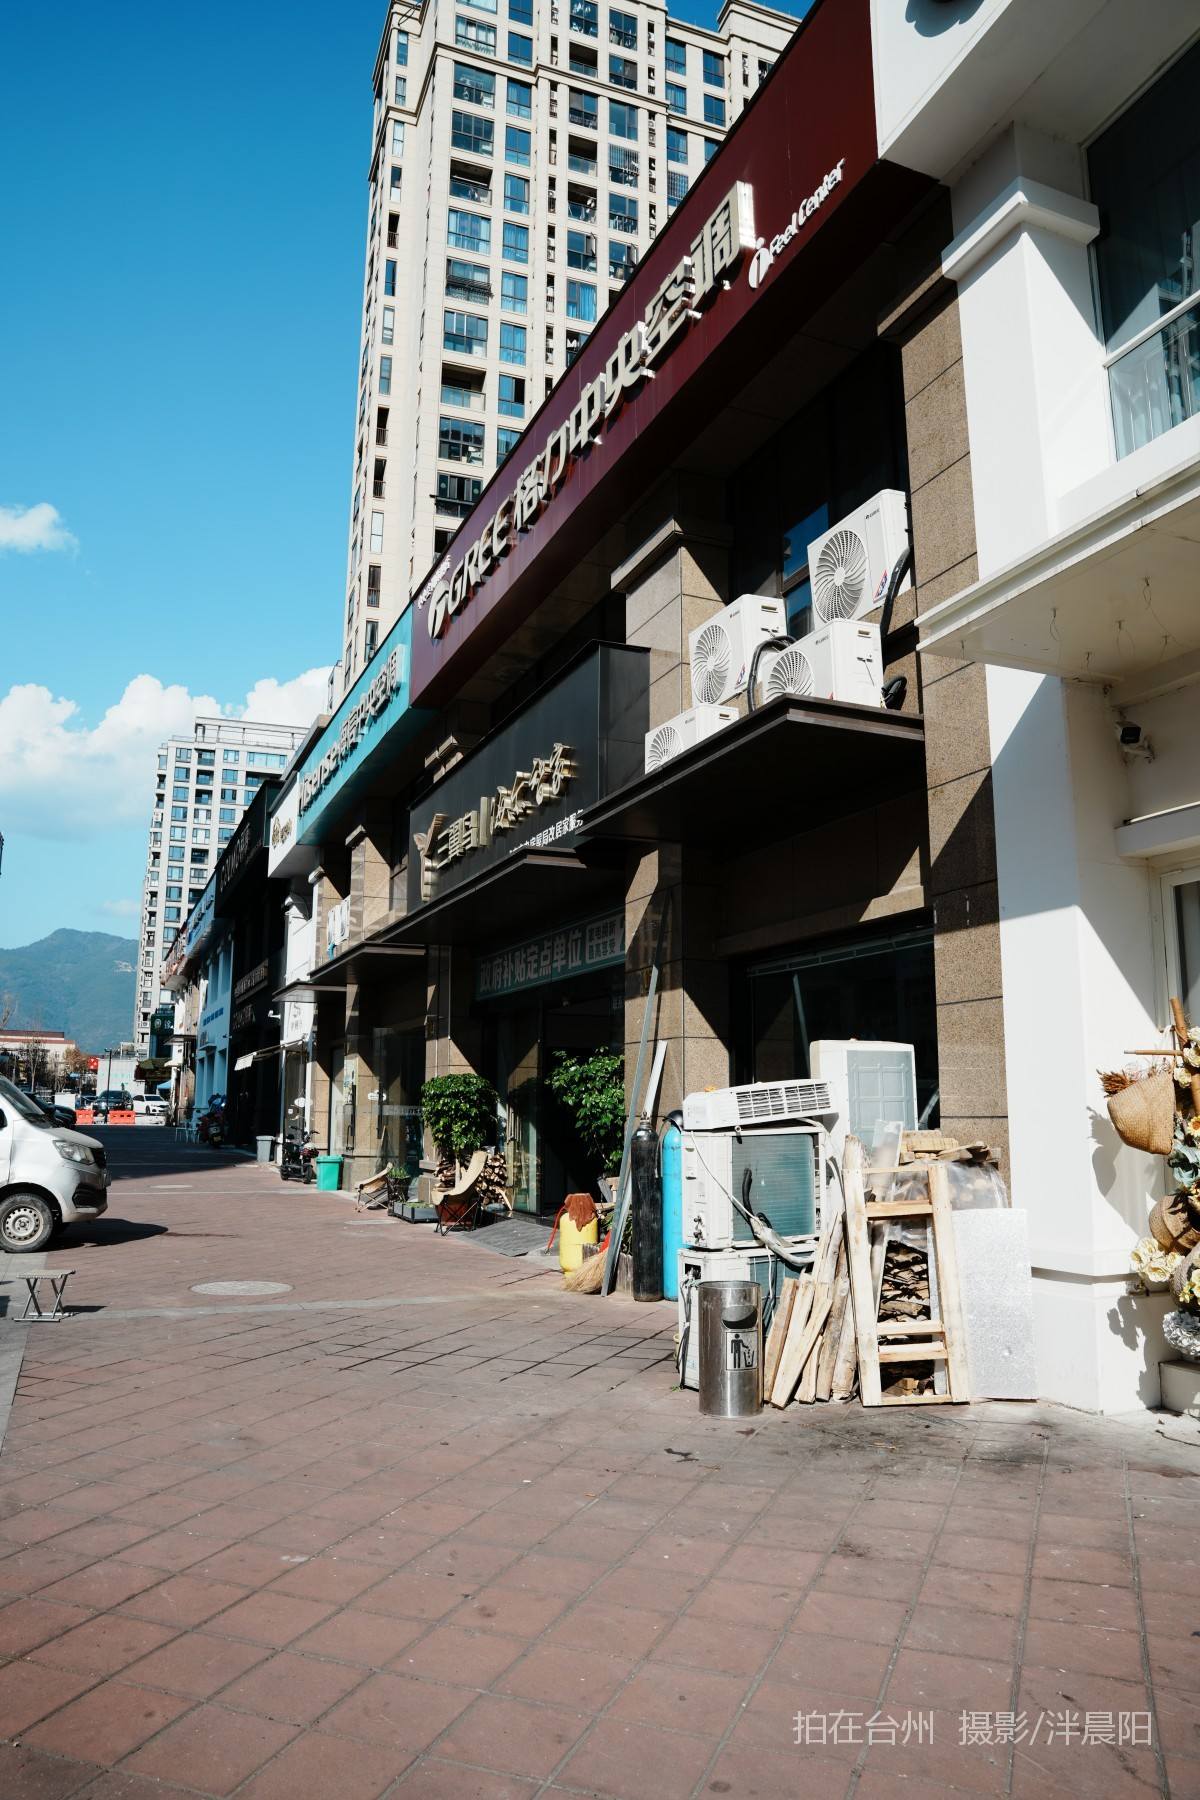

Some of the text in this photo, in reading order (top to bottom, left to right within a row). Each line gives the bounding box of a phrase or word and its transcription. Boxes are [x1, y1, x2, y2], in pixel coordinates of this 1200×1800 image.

[798, 157, 846, 226] Center
[448, 182, 750, 614] GREE 格力中央空调
[480, 930, 582, 993] 政府补贴定点单位
